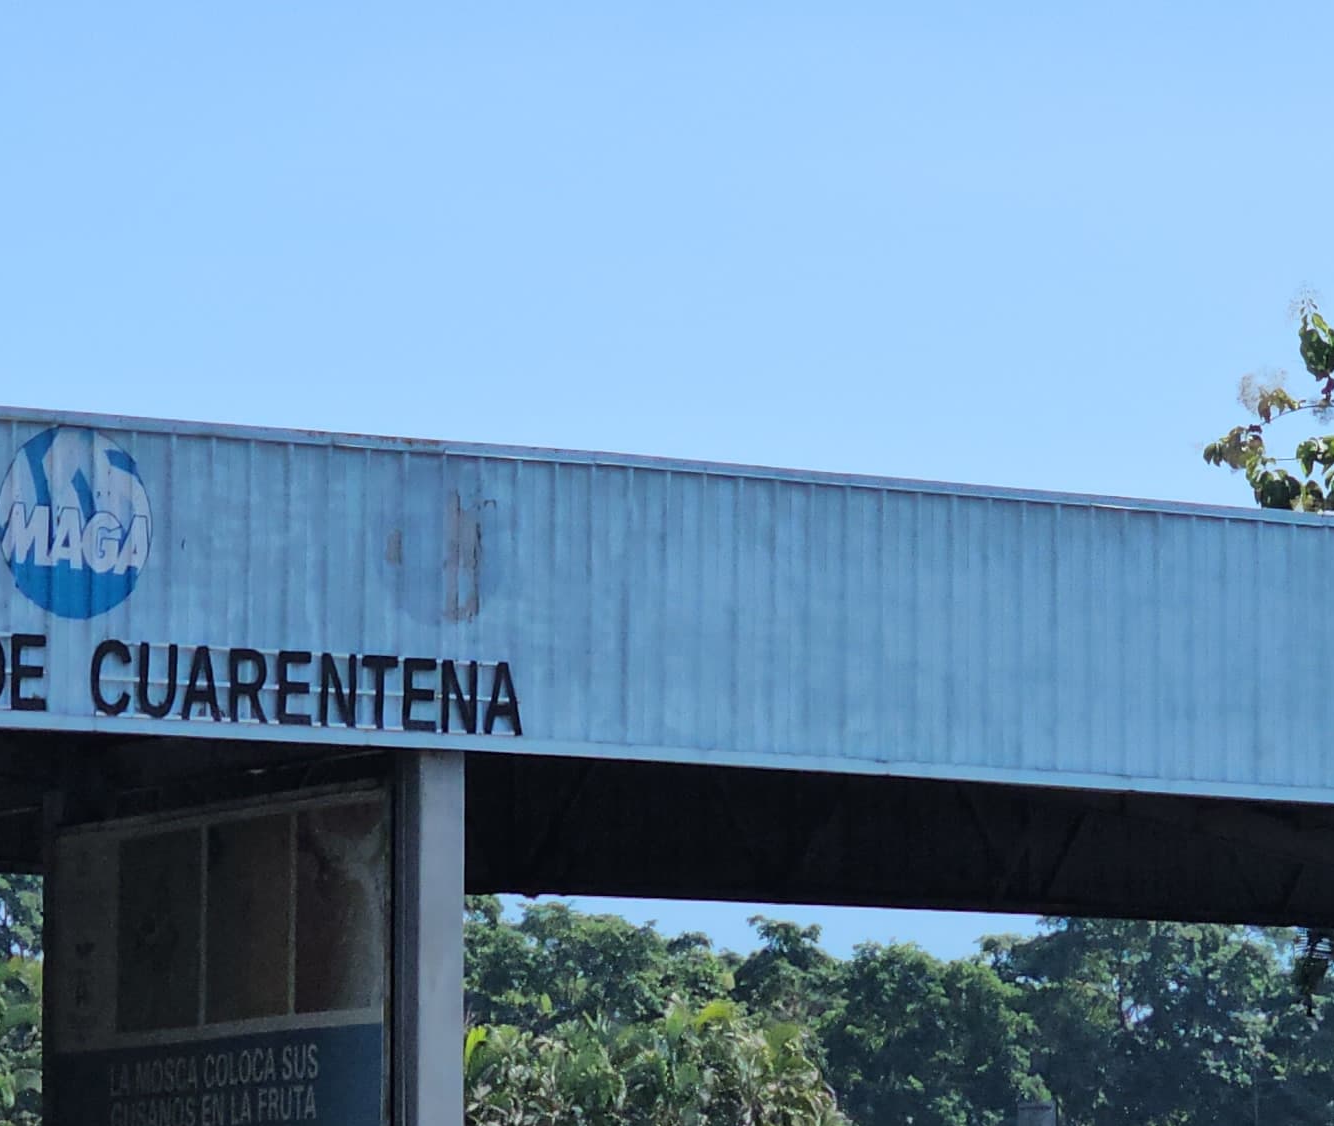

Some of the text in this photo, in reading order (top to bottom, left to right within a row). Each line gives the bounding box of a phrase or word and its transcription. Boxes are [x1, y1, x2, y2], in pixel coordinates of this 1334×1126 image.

[2, 502, 149, 575] MAGA
[90, 639, 523, 736] CUARENTENA
[108, 1043, 319, 1097] LA MOSCA COLOCA SUS
[230, 1090, 251, 1125] LA
[258, 1085, 317, 1122] FRUTA
